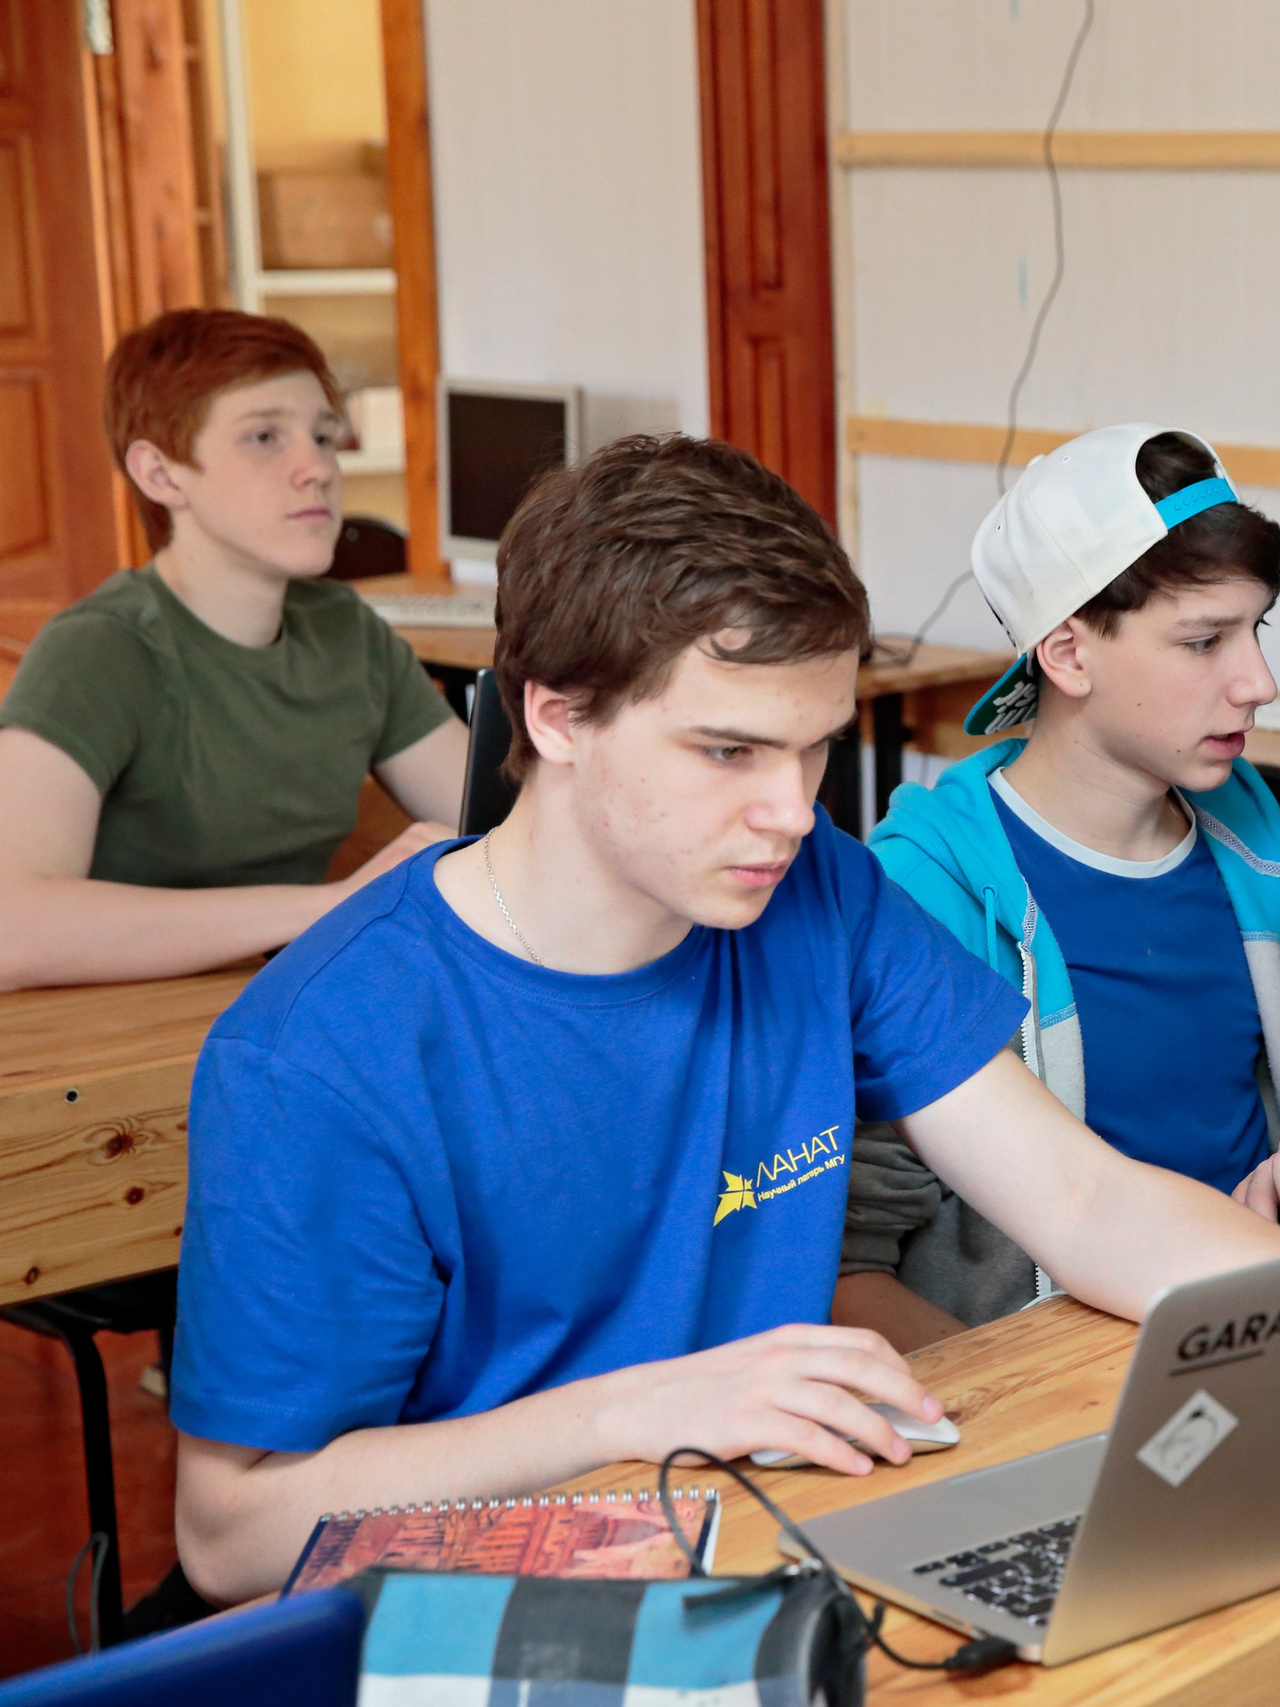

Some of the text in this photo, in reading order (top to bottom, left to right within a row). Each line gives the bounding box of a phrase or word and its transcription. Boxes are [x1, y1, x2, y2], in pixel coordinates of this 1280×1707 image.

[756, 1125, 840, 1188] ЛАНАТ
[757, 1179, 797, 1202] Научный
[797, 1166, 825, 1186] лагерь
